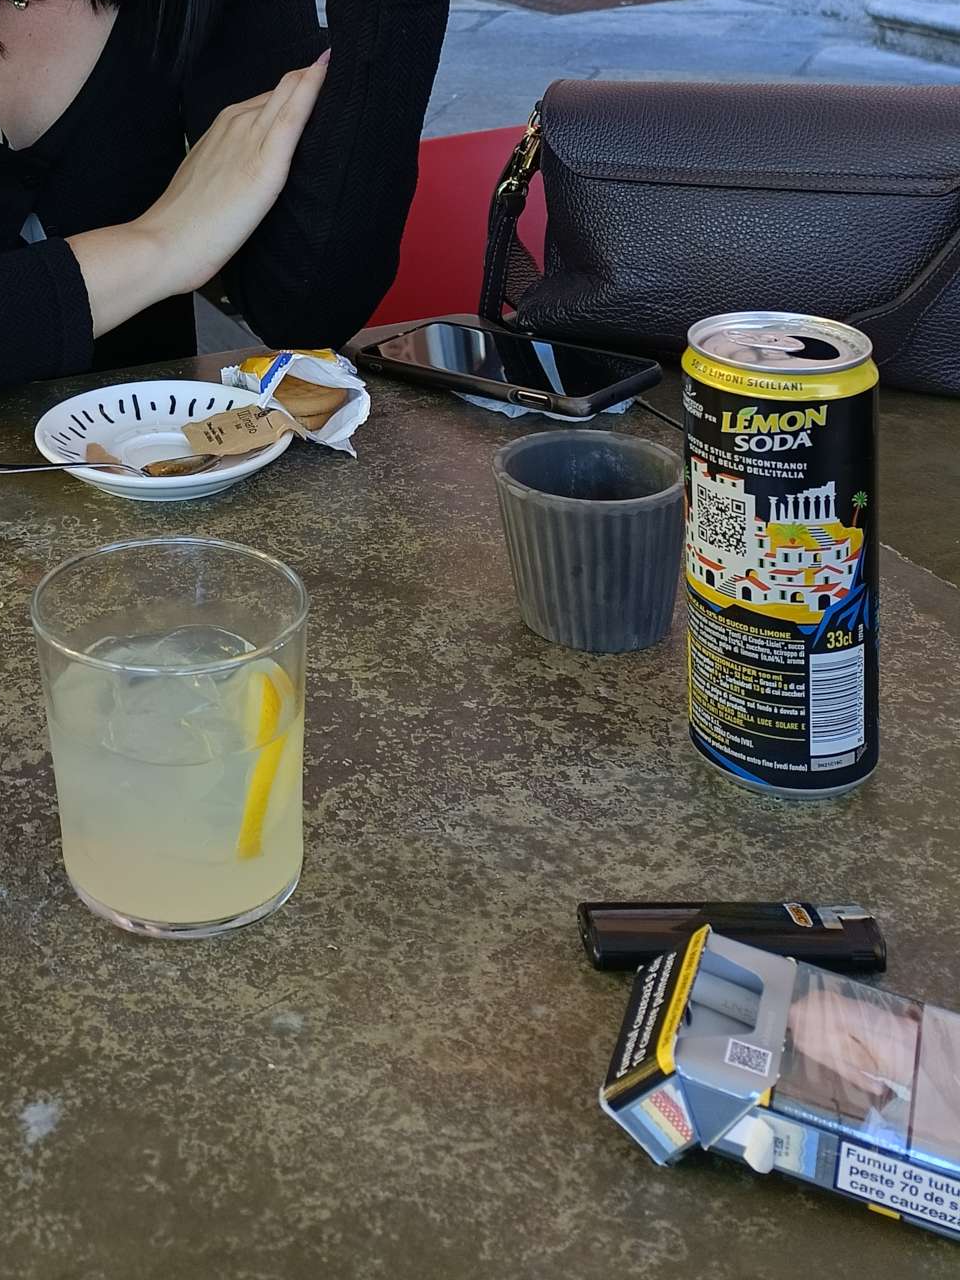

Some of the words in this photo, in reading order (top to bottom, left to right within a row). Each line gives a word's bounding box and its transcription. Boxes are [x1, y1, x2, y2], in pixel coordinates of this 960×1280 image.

[708, 368, 744, 385] LIMONI
[746, 378, 804, 392] SICILIANI
[721, 404, 828, 434] LEMON
[734, 431, 813, 452] SODA
[710, 446, 732, 460] STILE
[734, 455, 808, 470] S'INCONTRANO!
[718, 458, 744, 472] BELLO
[746, 465, 804, 479] DELL'ITALIA
[726, 618, 748, 632] SUCCO
[750, 626, 758, 634] DI
[760, 628, 792, 640] LIMONE
[826, 630, 852, 649] 33cl
[742, 666, 757, 677] PER
[758, 718, 772, 727] LUCE
[776, 722, 798, 730] SOLARE
[846, 1148, 898, 1175] Fumul
[903, 1170, 924, 1184] de
[850, 1166, 894, 1188] peste
[900, 1181, 918, 1196] 70
[924, 1192, 944, 1206] de
[850, 1180, 885, 1199] care
